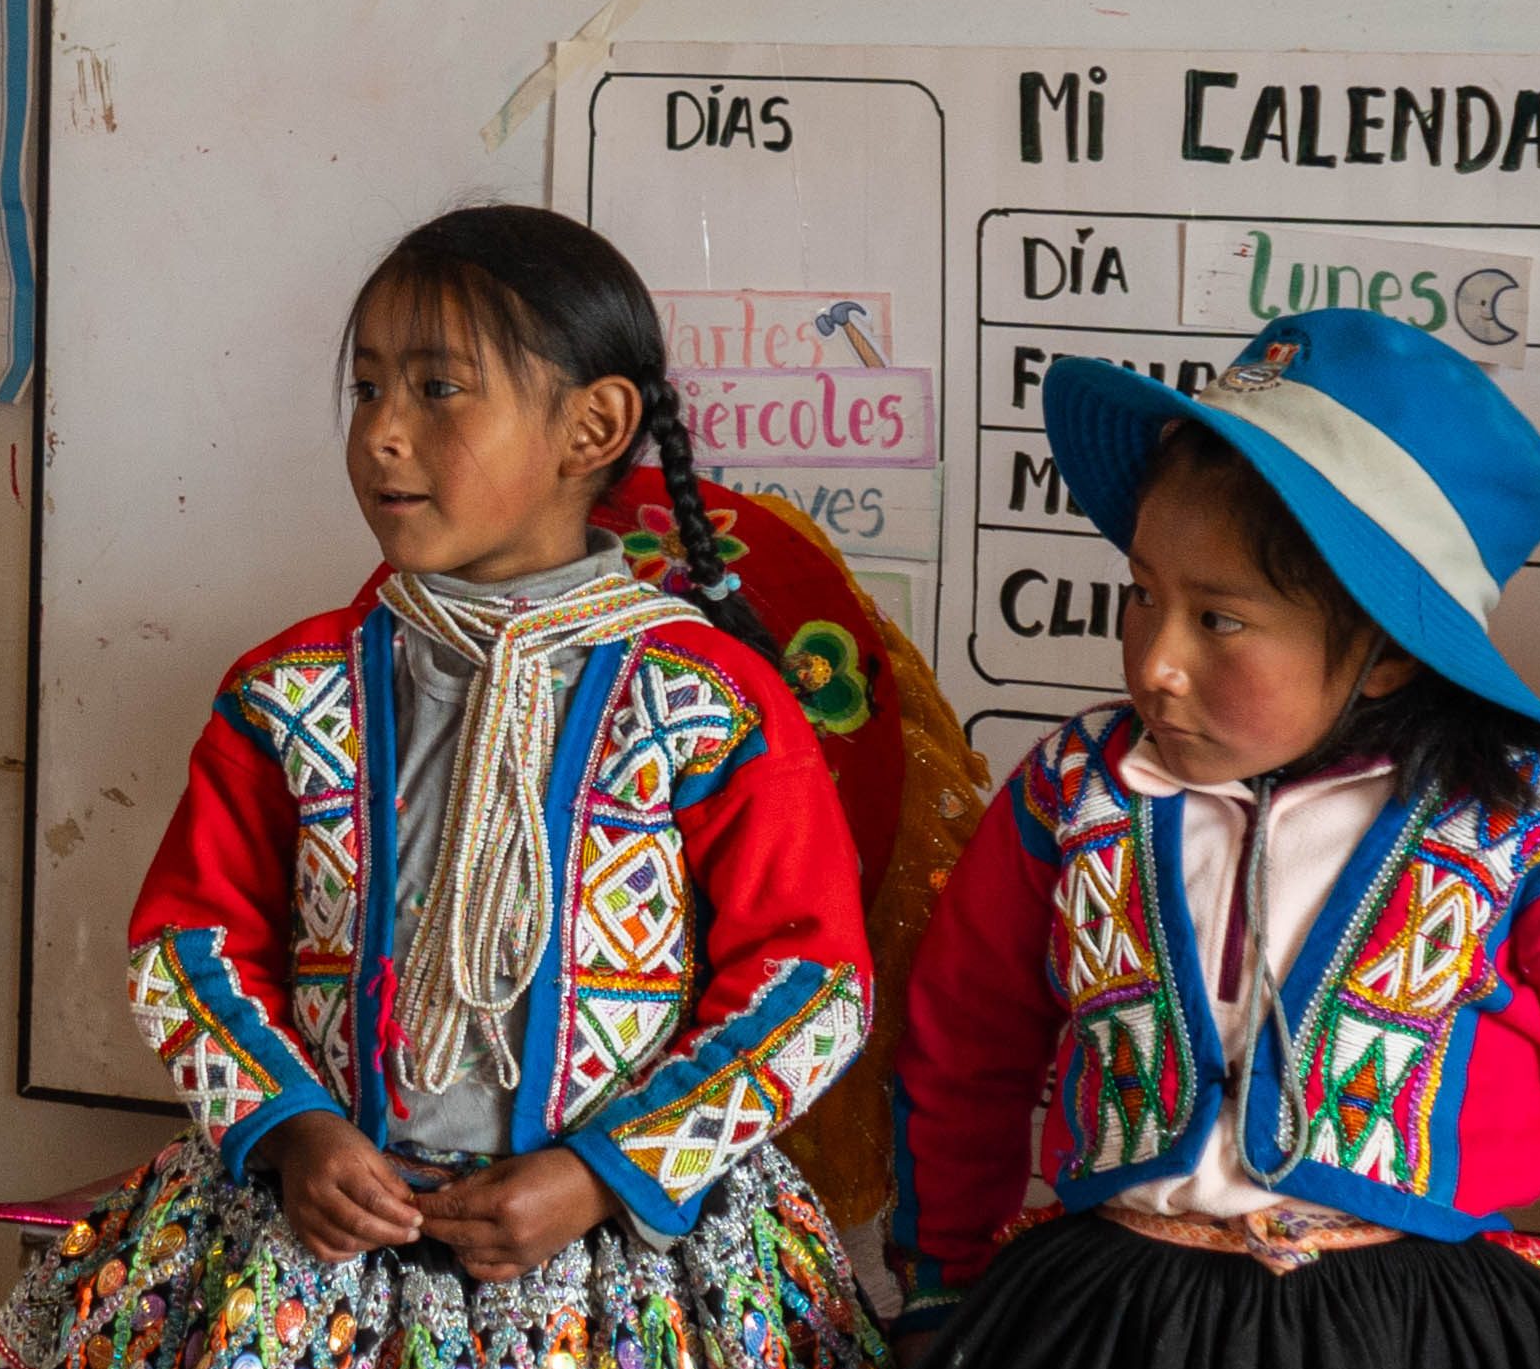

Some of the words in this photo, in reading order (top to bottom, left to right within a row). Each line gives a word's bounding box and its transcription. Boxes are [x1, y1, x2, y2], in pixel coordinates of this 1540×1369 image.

[666, 84, 794, 151] DÍAS
[1023, 229, 1128, 300] DÍA
[674, 373, 905, 449] iércoles
